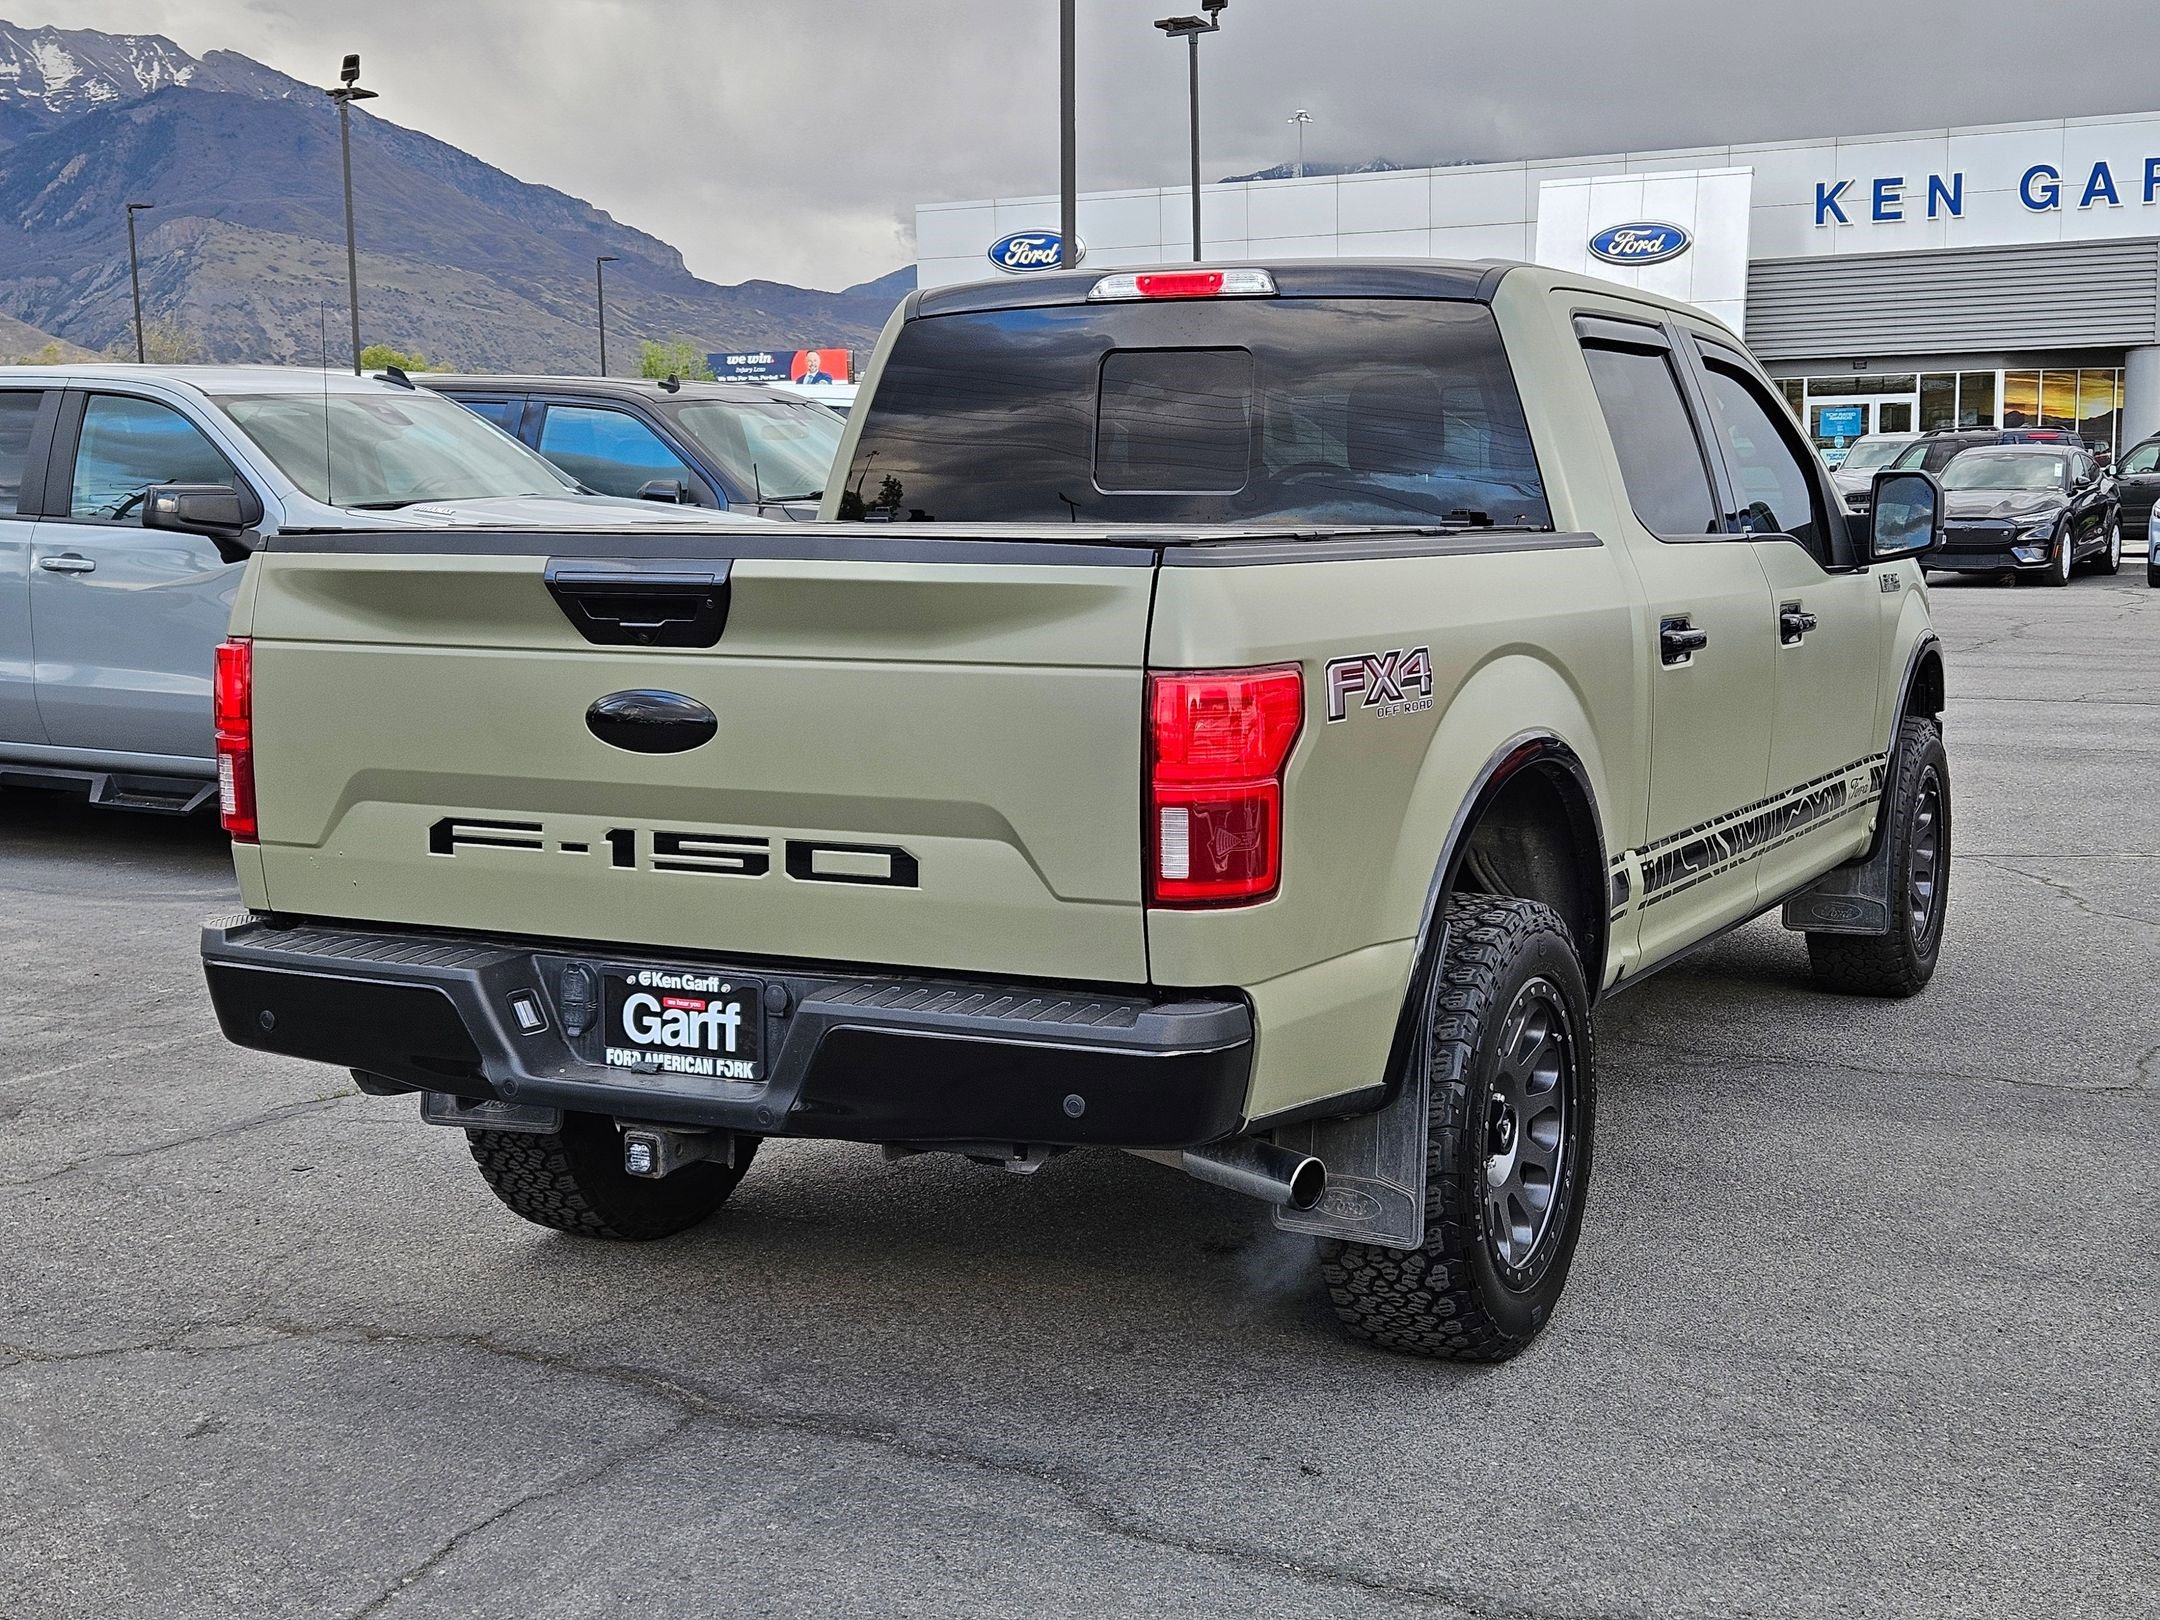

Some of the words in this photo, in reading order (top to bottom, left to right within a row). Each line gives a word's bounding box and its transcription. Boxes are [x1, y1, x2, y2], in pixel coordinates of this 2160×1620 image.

[1814, 171, 1966, 227] KEN
[1004, 238, 1060, 265] Ford
[1608, 229, 1667, 255] Ford
[726, 355, 746, 365] we
[747, 352, 775, 364] win.
[1324, 645, 1433, 724] FX4
[1376, 705, 1400, 719] OFF
[1404, 699, 1433, 713] ROAD
[427, 816, 920, 890] F-150
[622, 992, 741, 1052] Garff
[605, 1048, 642, 1067] FORD
[644, 1053, 713, 1076] AMERICAN
[715, 1059, 754, 1080] FORK
